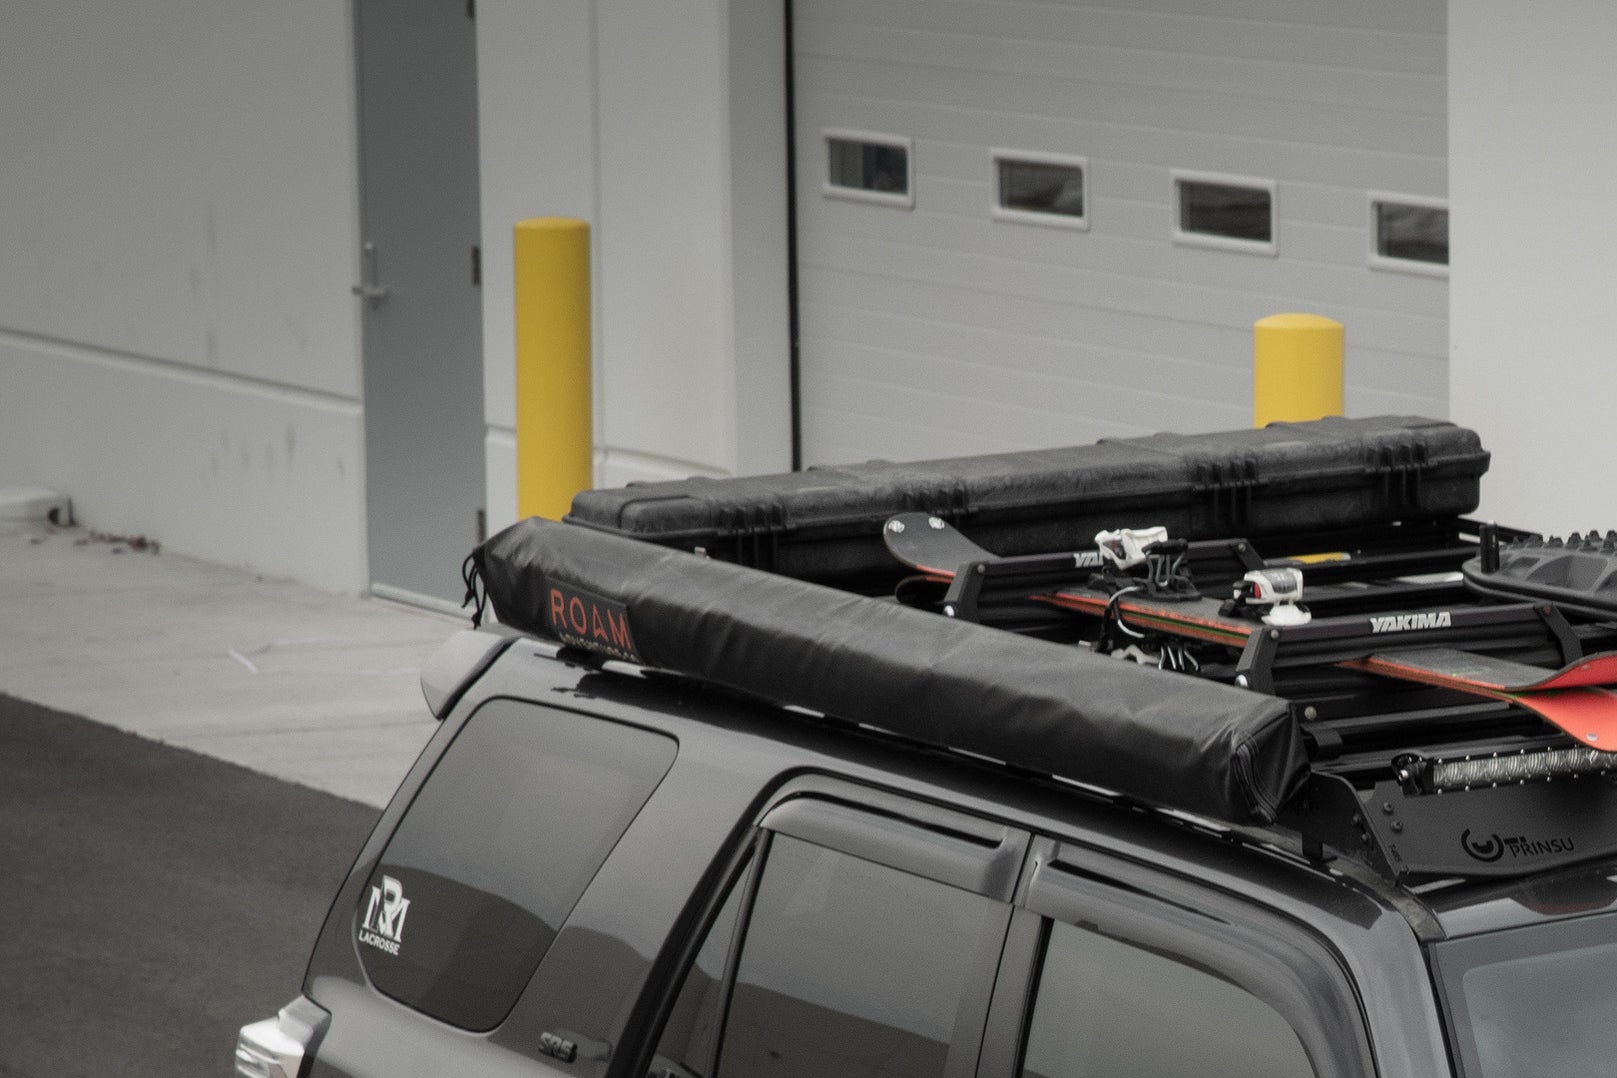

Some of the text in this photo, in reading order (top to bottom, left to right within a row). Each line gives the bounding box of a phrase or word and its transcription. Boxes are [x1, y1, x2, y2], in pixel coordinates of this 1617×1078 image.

[550, 587, 632, 650] ROAM
[1369, 611, 1451, 634] YAKIMA
[1508, 837, 1575, 858] PRINSU
[358, 929, 401, 956] LACROSSE
[540, 1031, 576, 1062] SR5
